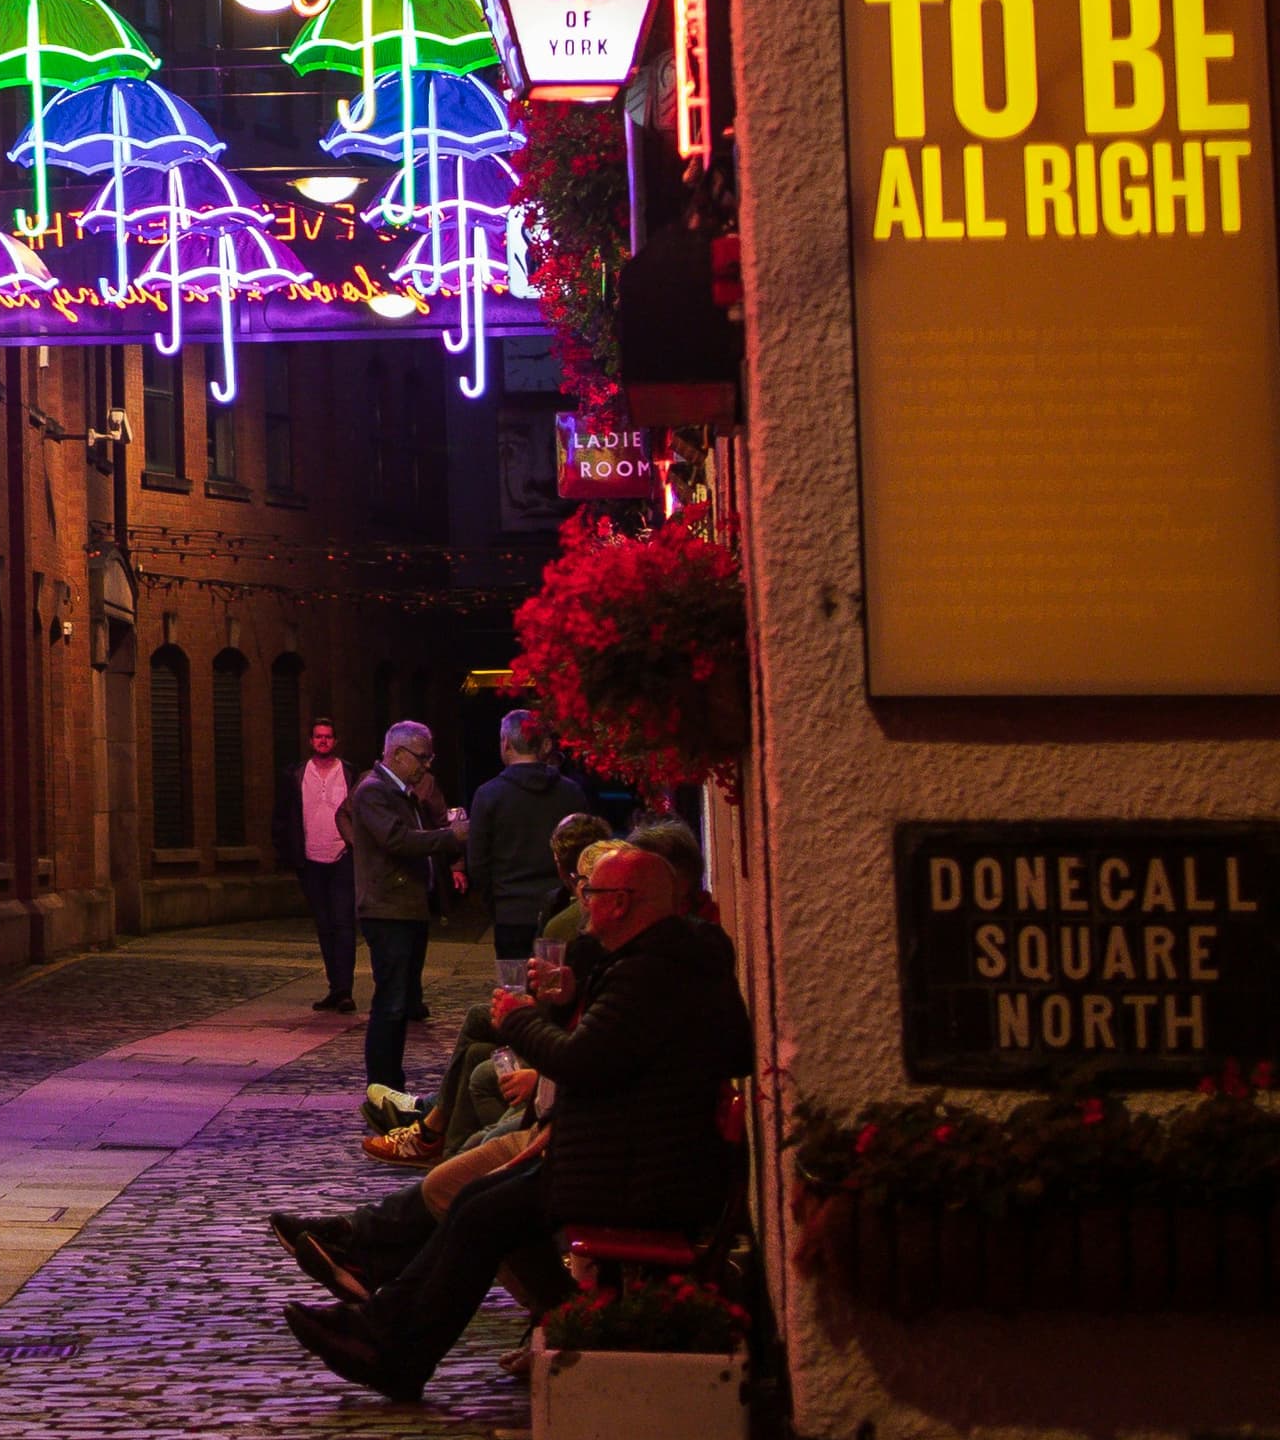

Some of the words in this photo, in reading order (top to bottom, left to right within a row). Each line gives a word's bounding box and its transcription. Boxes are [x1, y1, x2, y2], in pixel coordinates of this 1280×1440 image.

[550, 38, 609, 56] YORK
[566, 10, 592, 28] OF
[873, 143, 1007, 240] ALL
[1024, 140, 1251, 238] RIGHT
[975, 924, 1219, 983] SQUARE
[997, 993, 1205, 1050] NORTH
